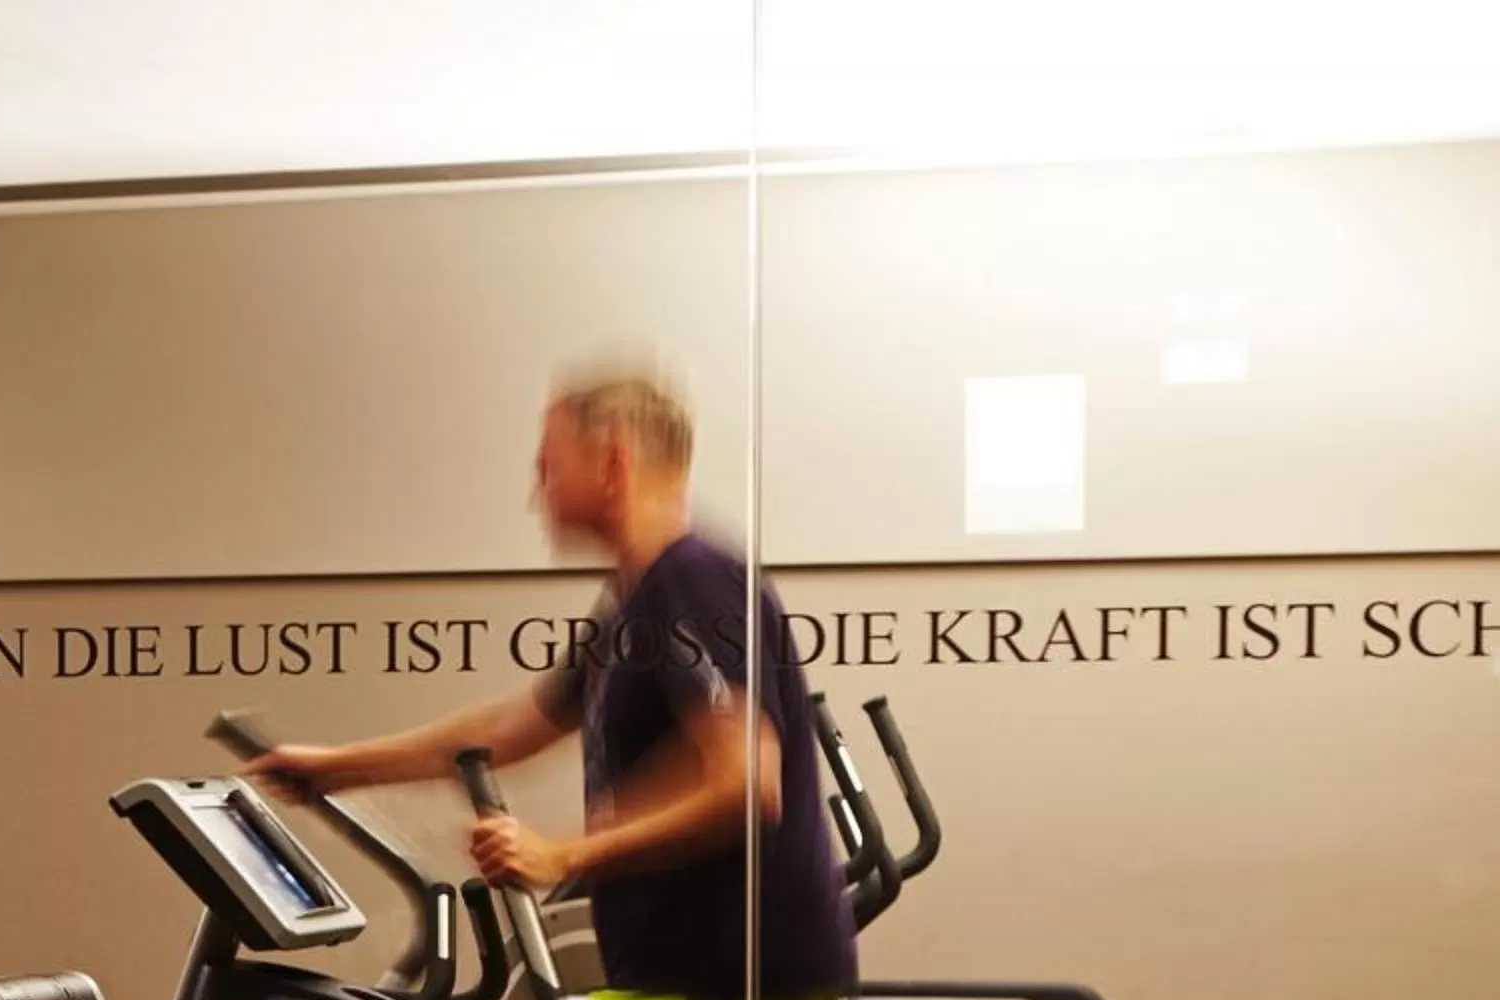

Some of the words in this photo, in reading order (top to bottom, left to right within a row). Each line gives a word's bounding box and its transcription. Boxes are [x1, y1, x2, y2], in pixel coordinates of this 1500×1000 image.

[52, 625, 164, 678] DIE
[184, 622, 358, 677] LUST
[383, 619, 489, 673] IST
[508, 614, 746, 673] GROSS
[775, 611, 901, 667] DIE
[923, 605, 1189, 665] KRAFT
[1212, 602, 1336, 661] IST
[1362, 599, 1500, 660] SCH
